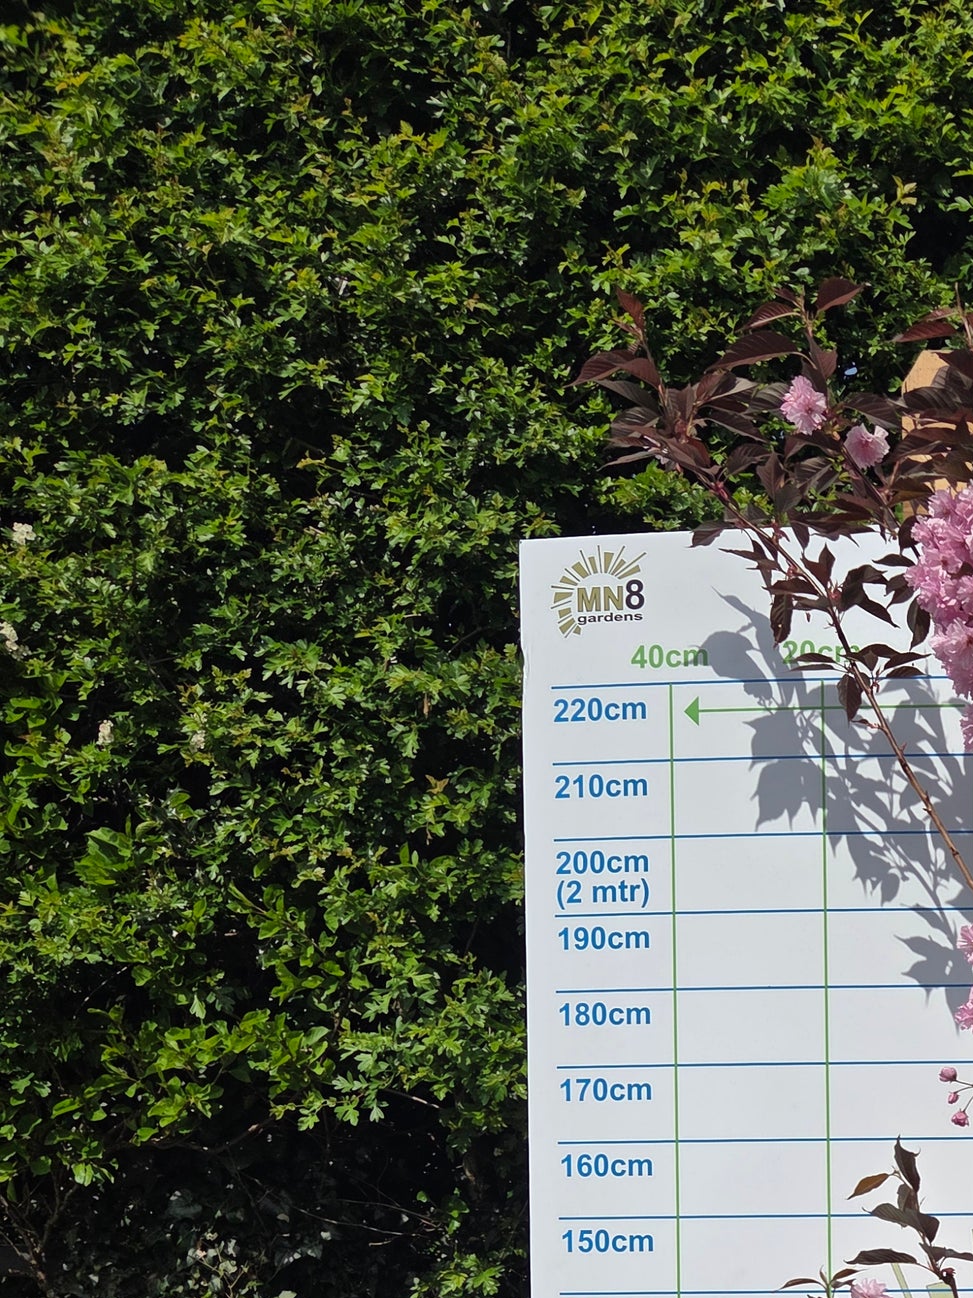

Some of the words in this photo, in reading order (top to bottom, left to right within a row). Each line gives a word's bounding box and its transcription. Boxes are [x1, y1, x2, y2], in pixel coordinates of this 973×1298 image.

[577, 579, 645, 612] MN8
[577, 612, 643, 625] gardens
[631, 644, 708, 668] 40cm
[553, 698, 647, 723] 220cm
[555, 775, 648, 798] 210cm
[556, 851, 649, 874] 200cm
[557, 879, 582, 910] (2
[592, 879, 650, 909] mtr)
[557, 927, 650, 950] 190cm
[559, 1003, 651, 1025] 180cm
[560, 1079, 652, 1101] 170cm
[561, 1154, 653, 1176] 160cm
[562, 1230, 654, 1252] 150cm
